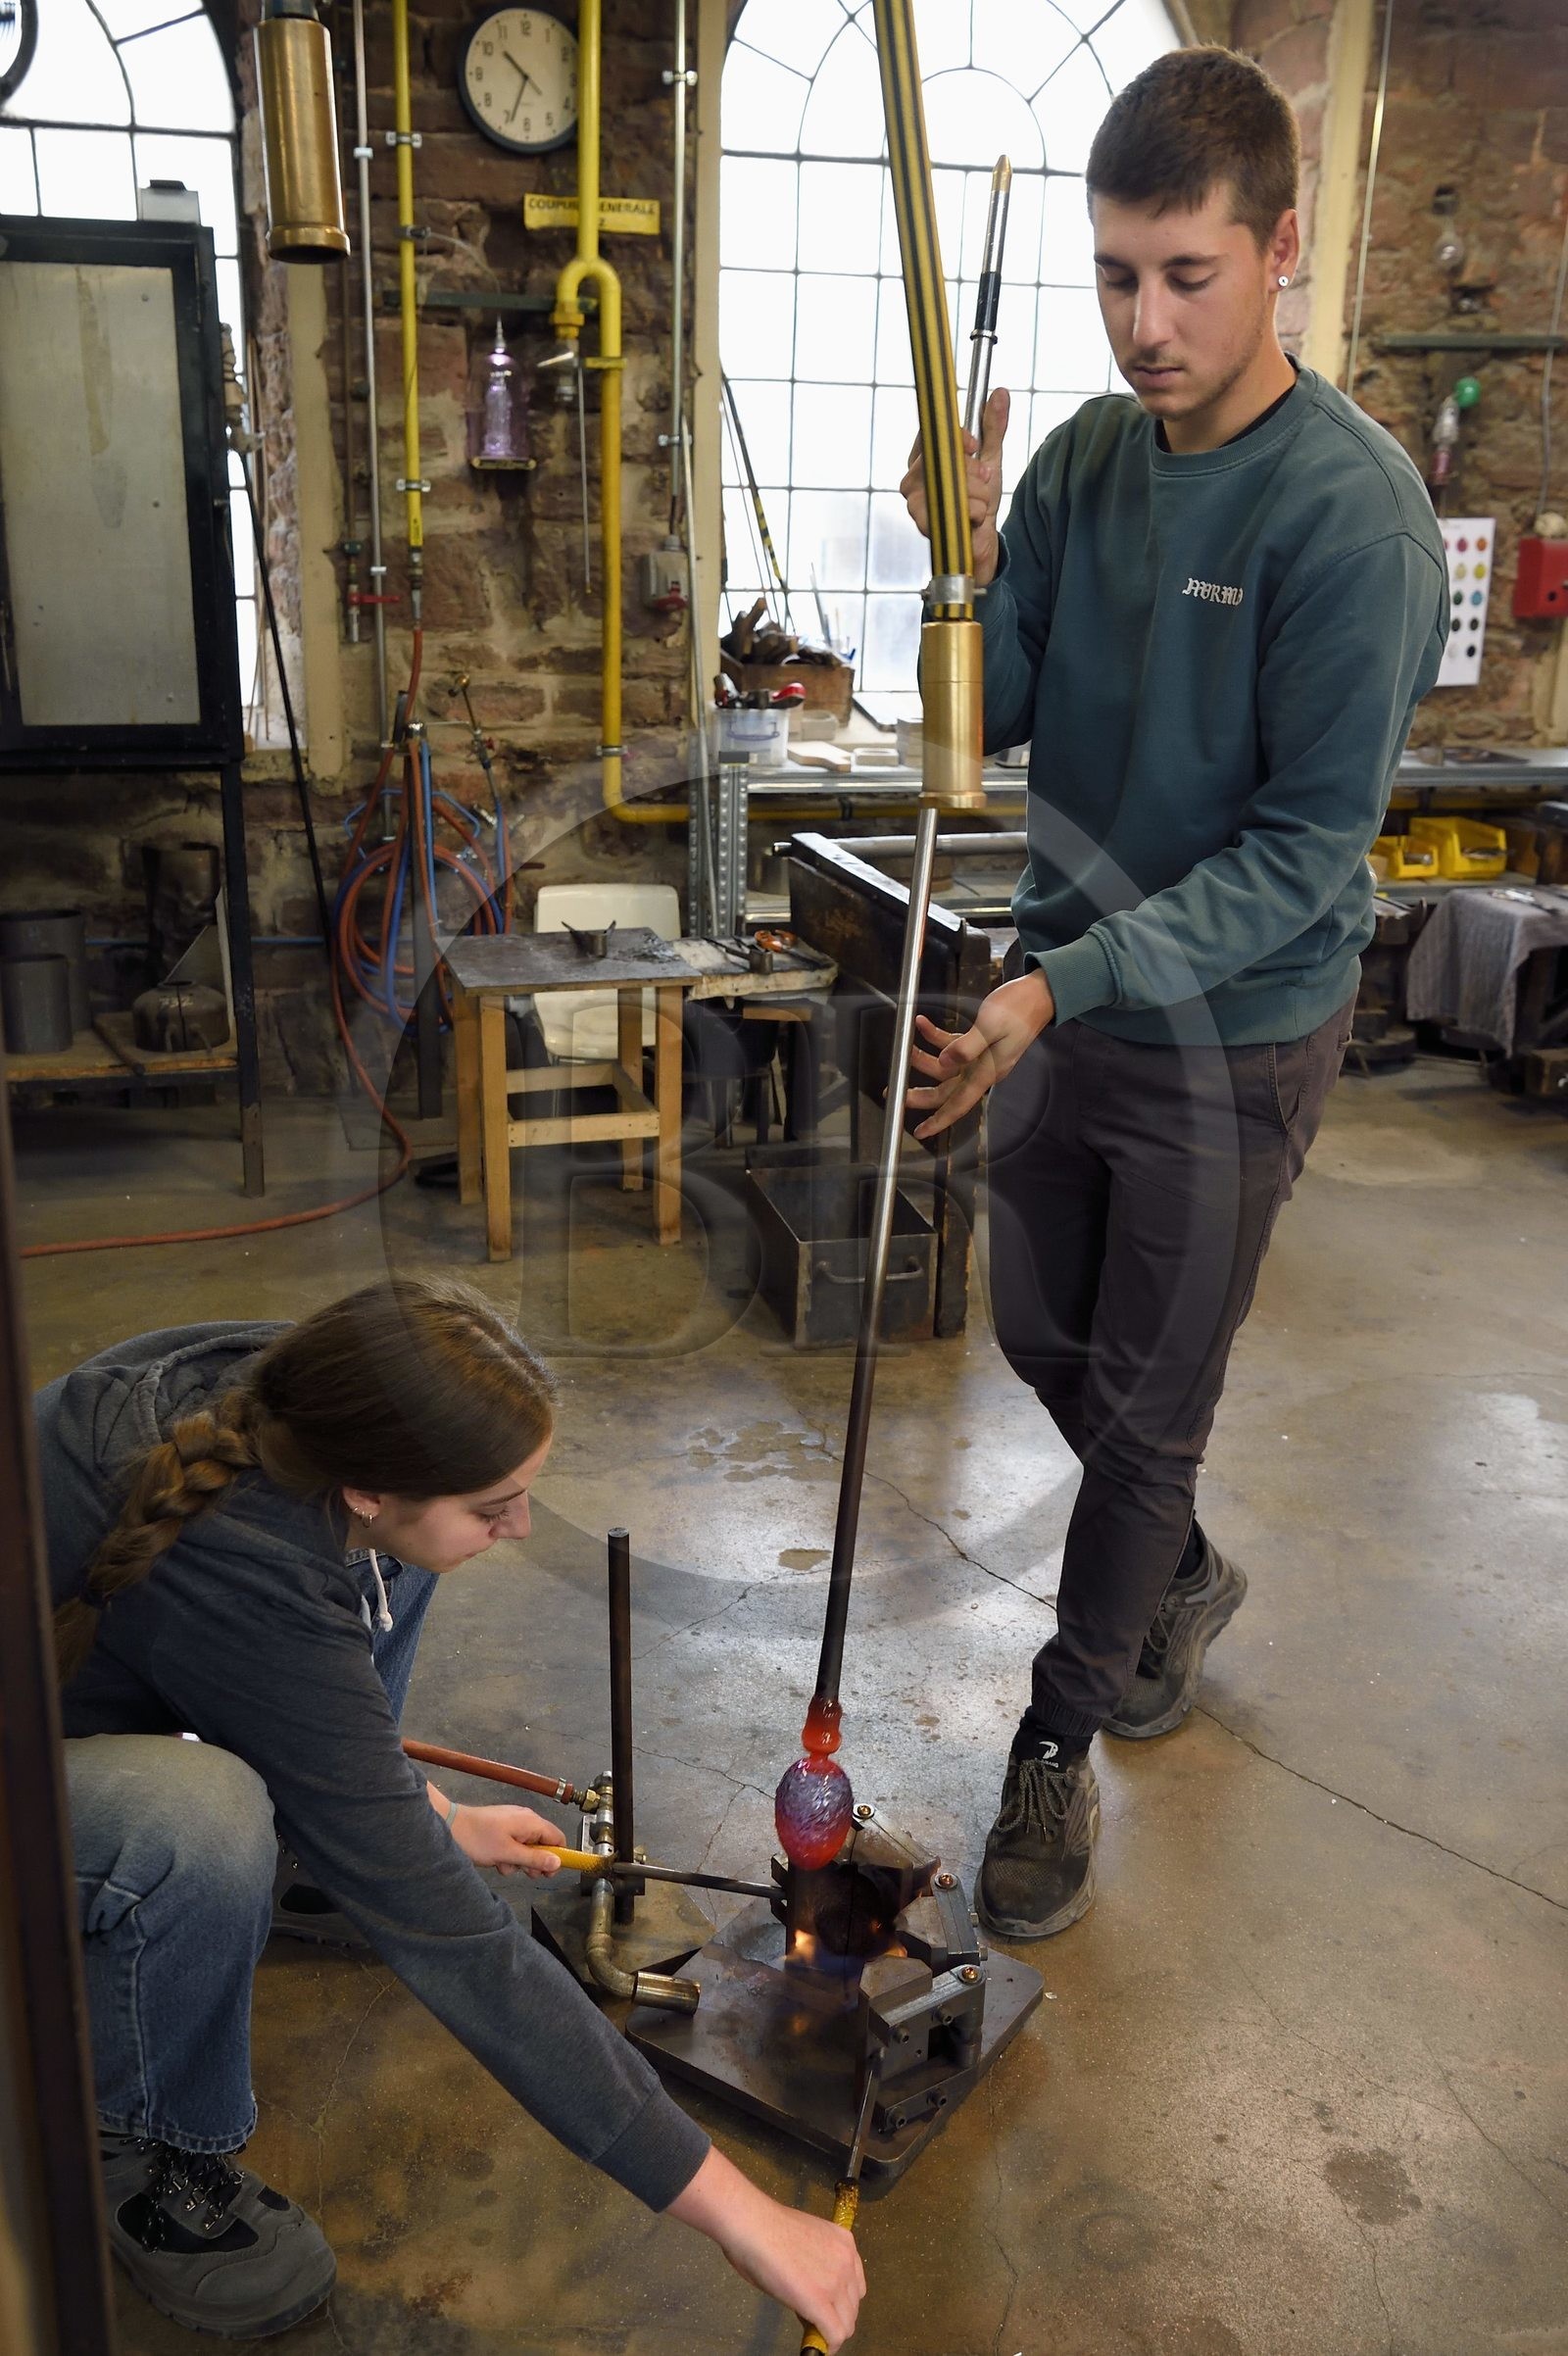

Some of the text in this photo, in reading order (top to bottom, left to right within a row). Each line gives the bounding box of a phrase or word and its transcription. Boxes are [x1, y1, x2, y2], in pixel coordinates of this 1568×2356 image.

[497, 25, 508, 40] 11
[520, 21, 531, 36] 12
[545, 27, 551, 43] 1
[482, 40, 494, 56] 10
[503, 110, 511, 123] 7
[523, 118, 531, 131] 6
[528, 197, 655, 215] COUPUR ENERALE
